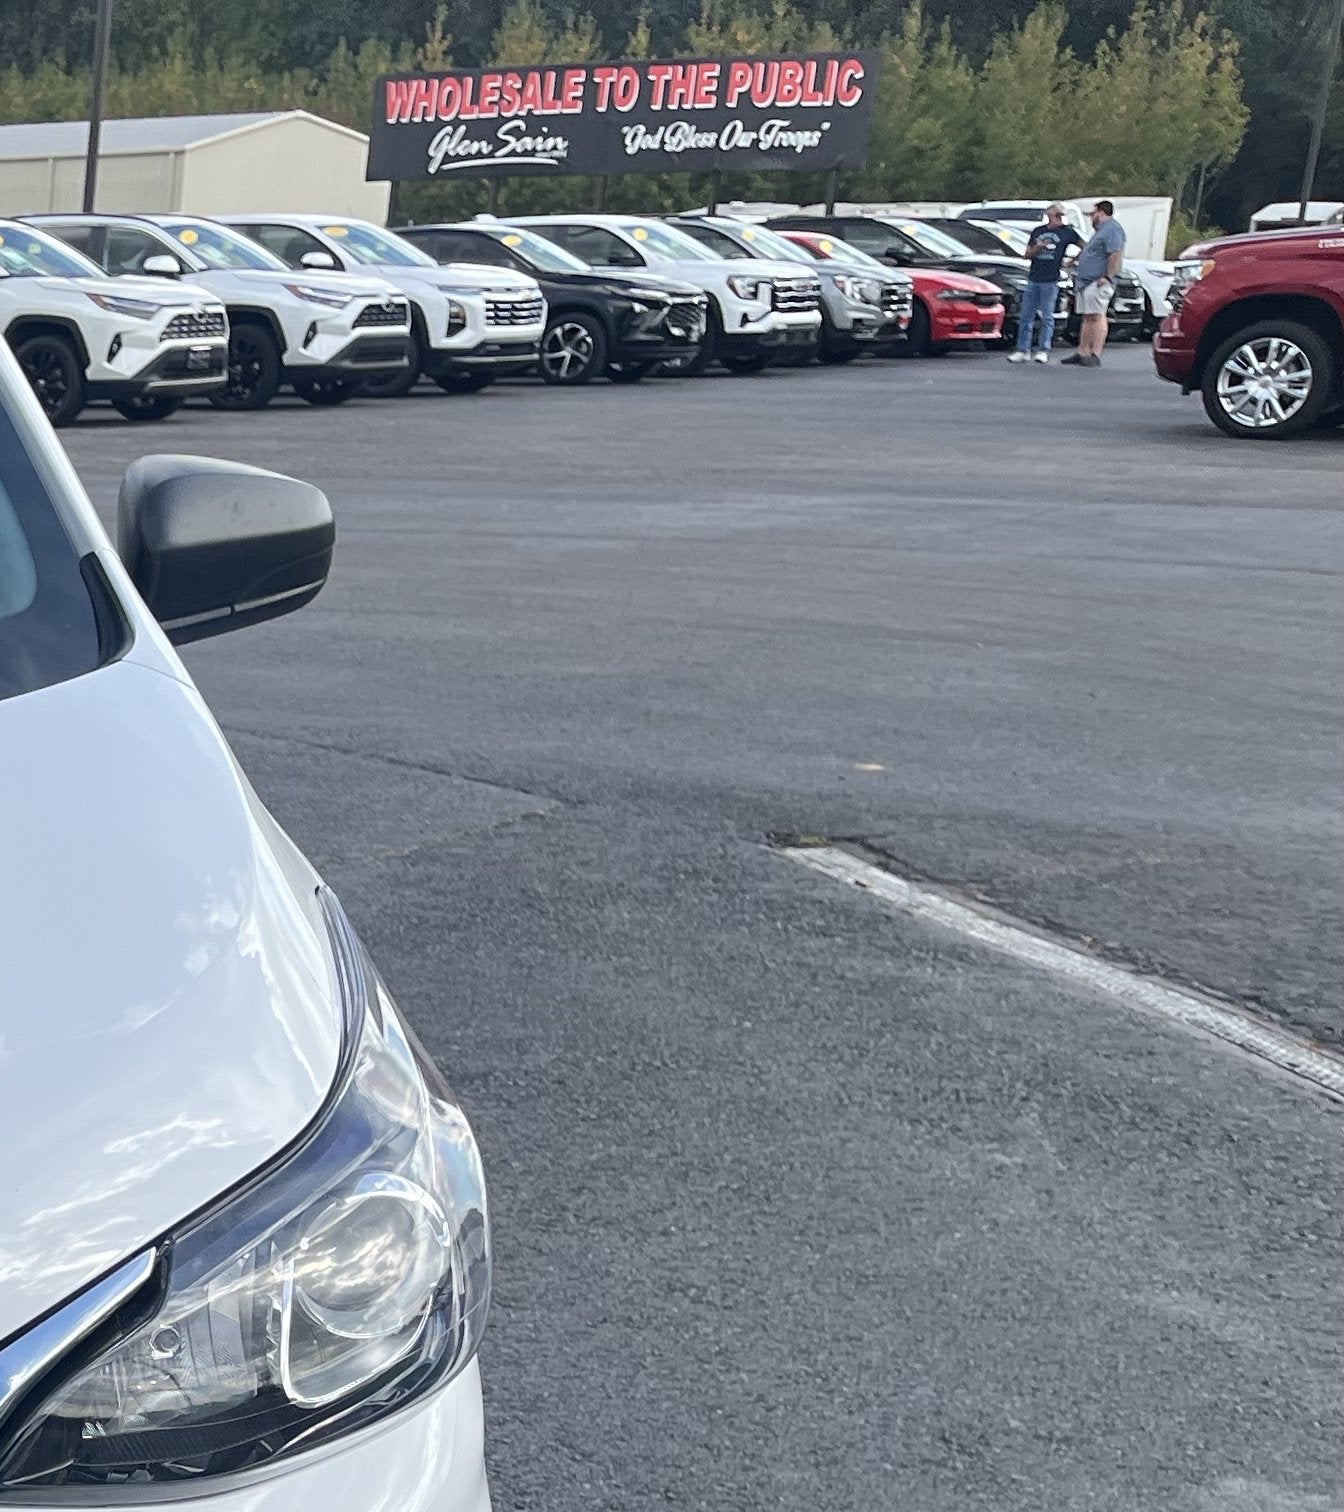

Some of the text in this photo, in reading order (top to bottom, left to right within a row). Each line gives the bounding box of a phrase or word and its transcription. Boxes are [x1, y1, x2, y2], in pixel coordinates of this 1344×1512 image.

[385, 58, 865, 125] WHOLESALE TO THE PUBLIC
[427, 119, 569, 175] Glen Sain
[664, 120, 719, 153] Bless
[718, 119, 758, 152] Our
